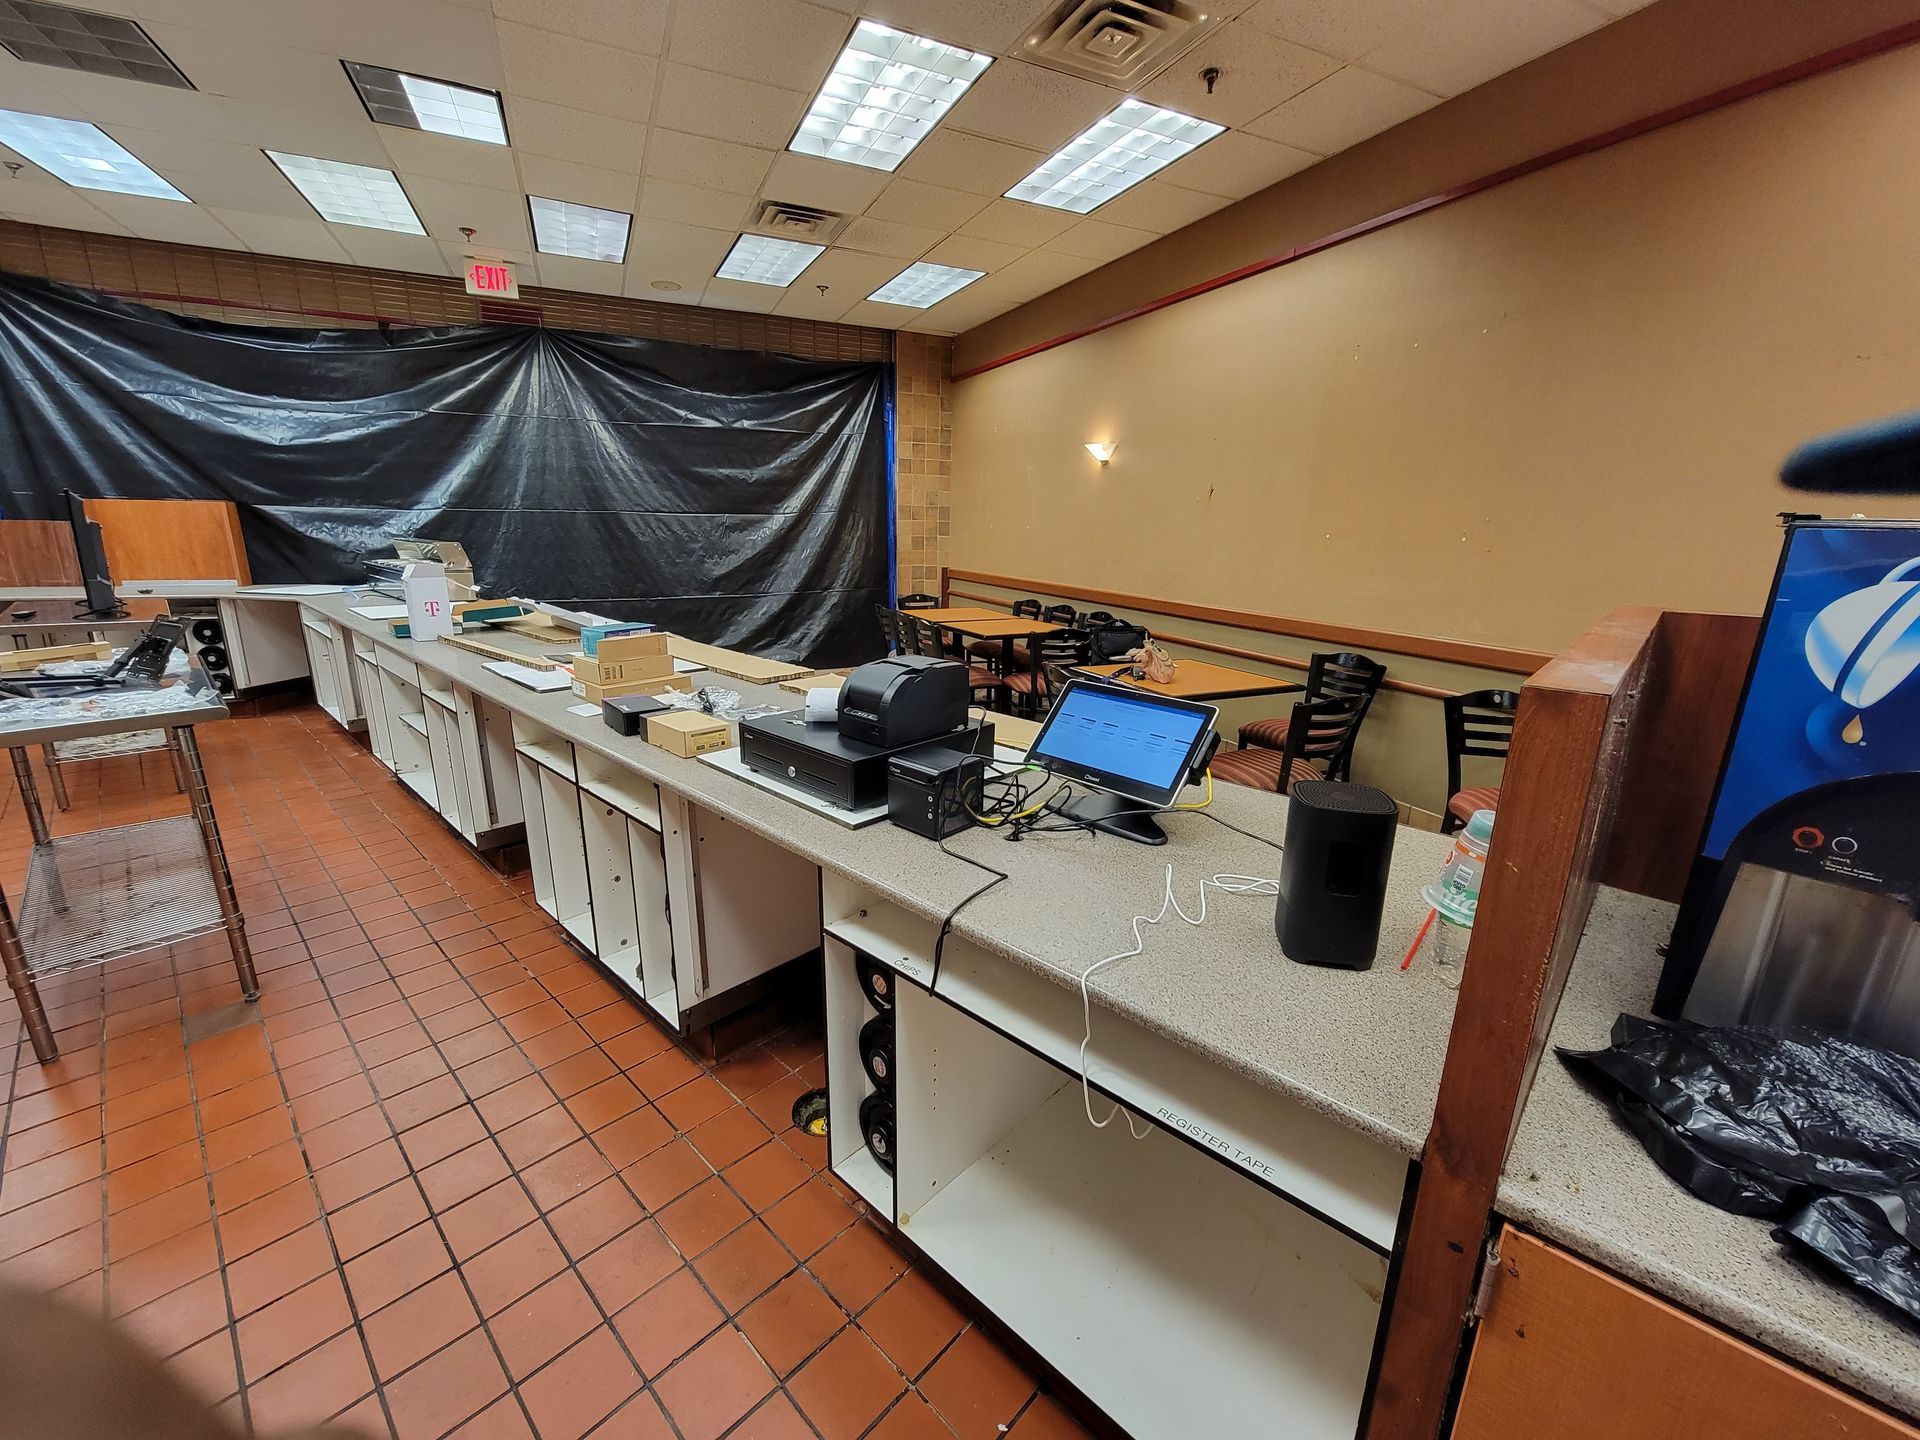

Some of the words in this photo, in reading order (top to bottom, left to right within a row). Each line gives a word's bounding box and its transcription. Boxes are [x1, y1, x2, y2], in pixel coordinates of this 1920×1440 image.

[474, 265, 507, 291] EXIT
[424, 601, 440, 617] T
[894, 960, 921, 976] CHIPS
[1157, 1107, 1230, 1153] REGISTER
[1235, 1148, 1275, 1178] TAPE
